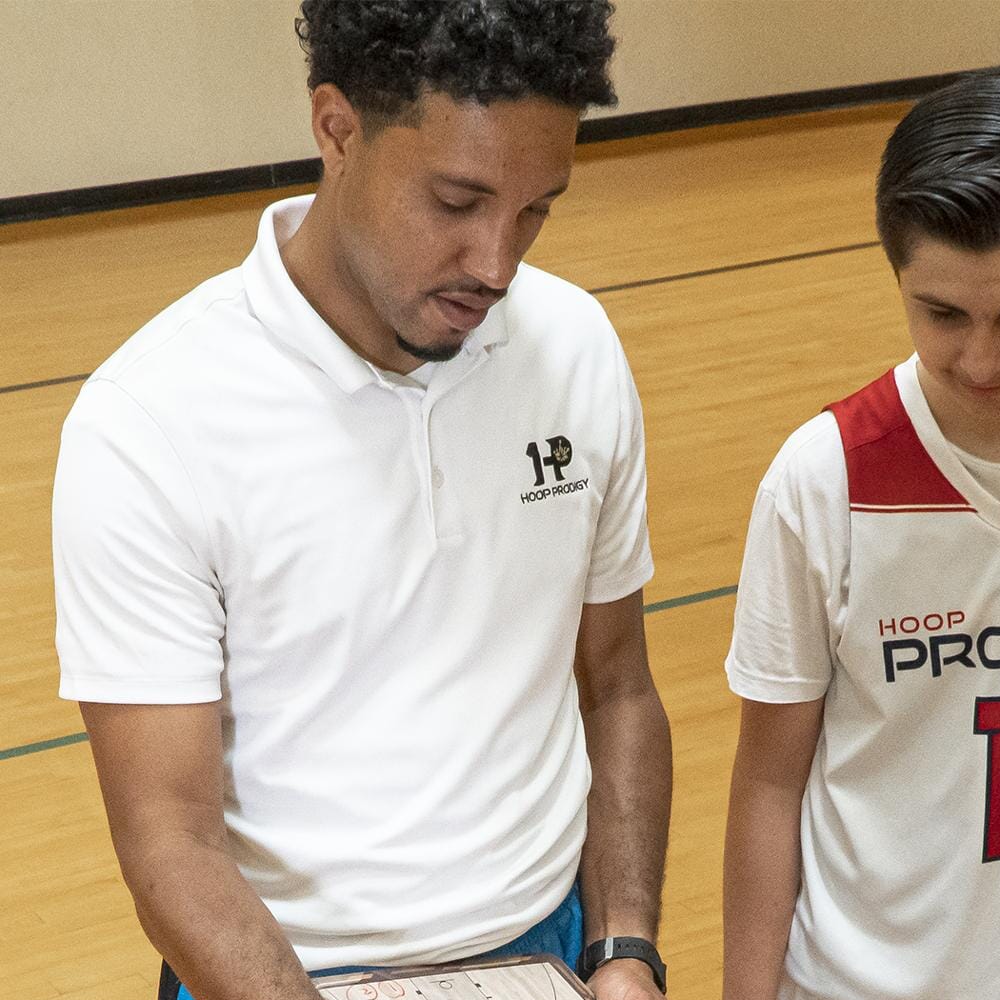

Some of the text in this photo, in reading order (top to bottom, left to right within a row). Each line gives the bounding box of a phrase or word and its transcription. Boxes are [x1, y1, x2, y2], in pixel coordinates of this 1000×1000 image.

[520, 478, 589, 504] HOOP PRODIGY
[879, 610, 966, 636] HOOP
